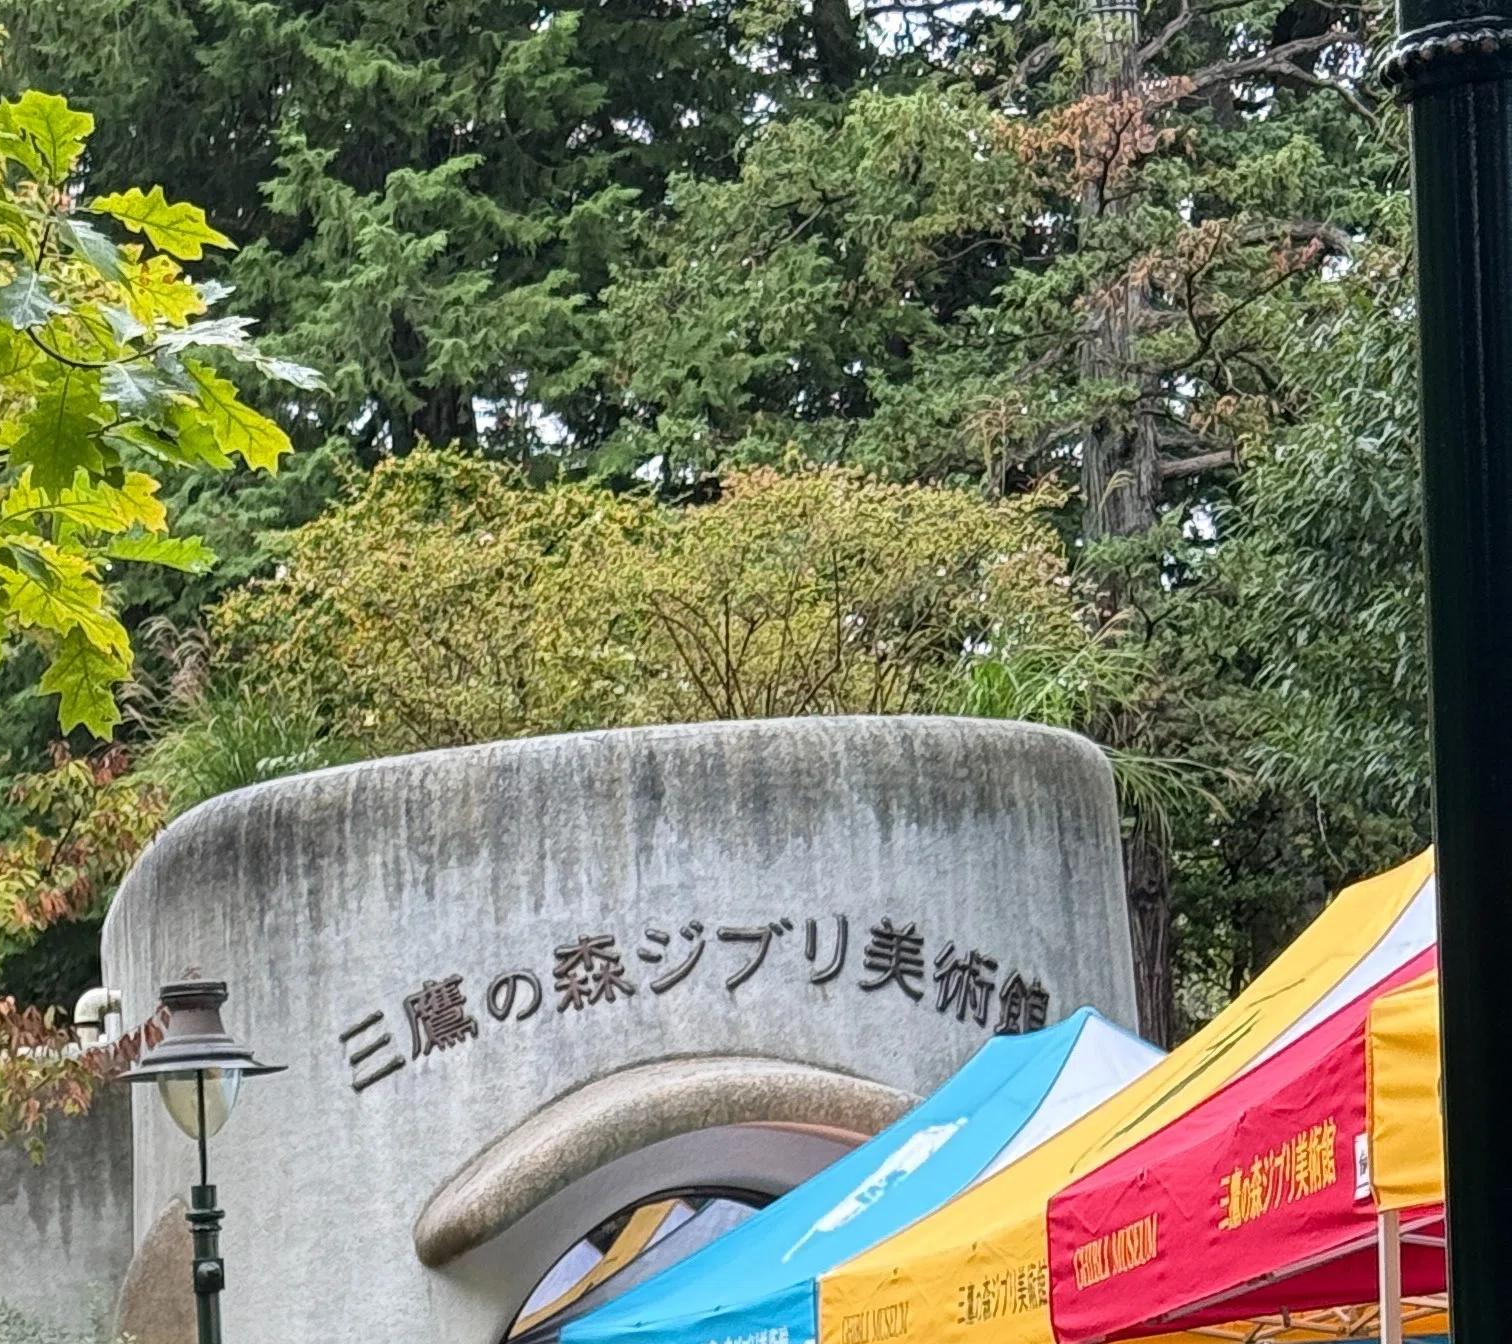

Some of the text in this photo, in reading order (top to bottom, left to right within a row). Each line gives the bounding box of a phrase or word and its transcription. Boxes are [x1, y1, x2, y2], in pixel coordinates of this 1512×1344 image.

[339, 914, 1050, 1092] 三鷹の森ジブリ美術館
[1218, 1116, 1337, 1230] 三鷹の森ジブリ美術館
